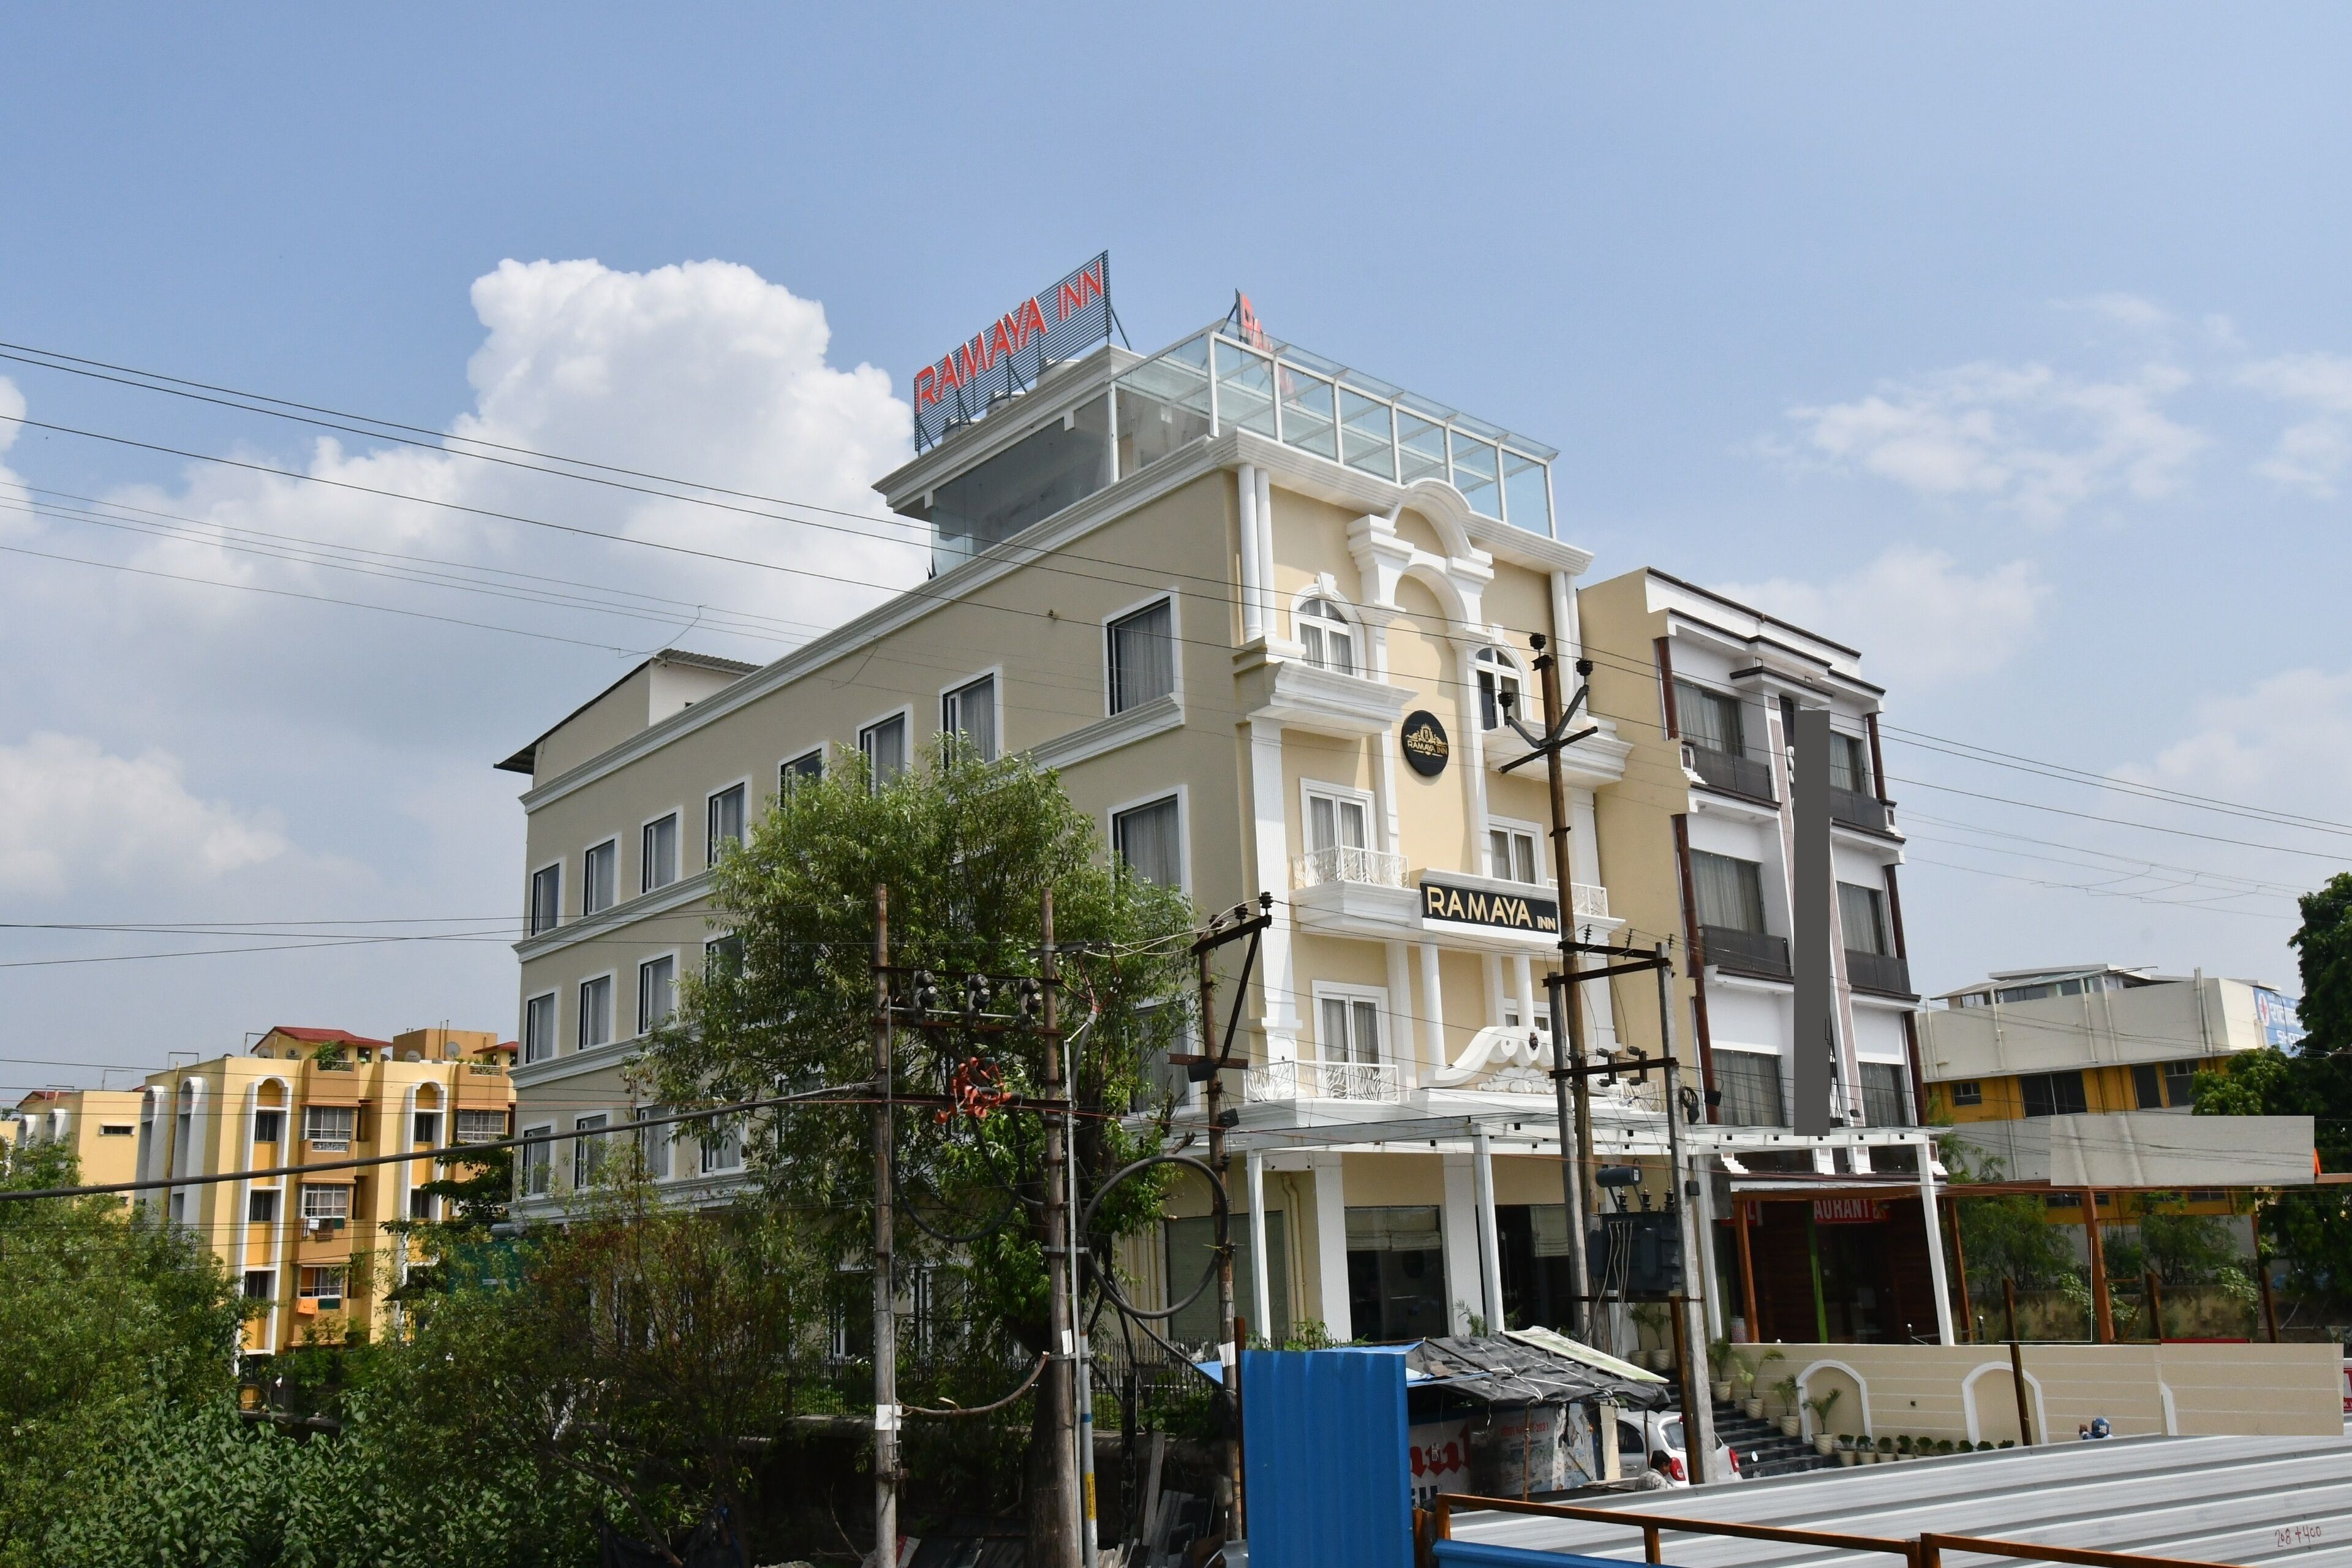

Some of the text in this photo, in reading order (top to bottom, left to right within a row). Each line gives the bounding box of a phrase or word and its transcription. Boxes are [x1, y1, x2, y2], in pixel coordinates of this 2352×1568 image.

[916, 260, 1103, 414] RAMAYA INN
[1407, 740, 1448, 755] RAMAYA INN
[1426, 886, 1556, 930] RAMAYA INN
